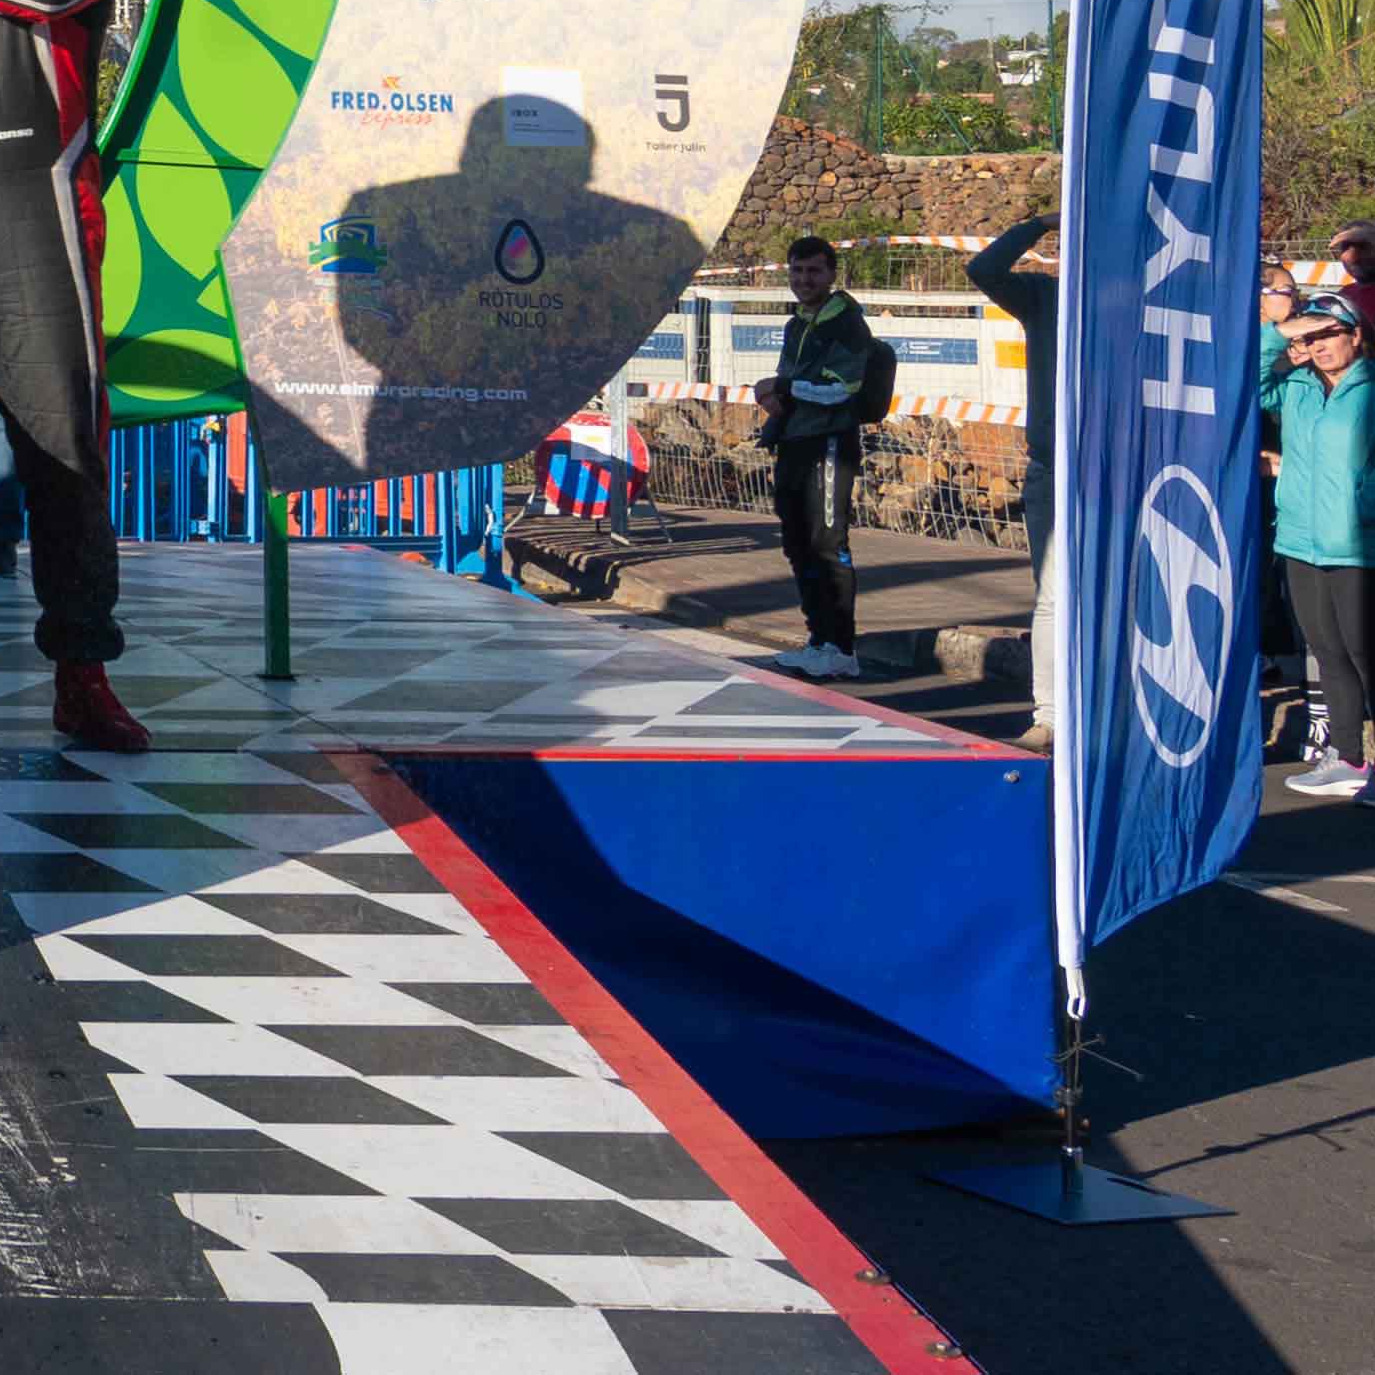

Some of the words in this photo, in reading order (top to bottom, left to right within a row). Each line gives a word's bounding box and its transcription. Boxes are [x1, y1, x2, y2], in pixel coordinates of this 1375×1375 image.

[330, 91, 387, 111] FRED.
[390, 92, 454, 113] OLSEN
[498, 312, 548, 328] NOLO
[275, 380, 528, 403] www.elmuroracing.com
